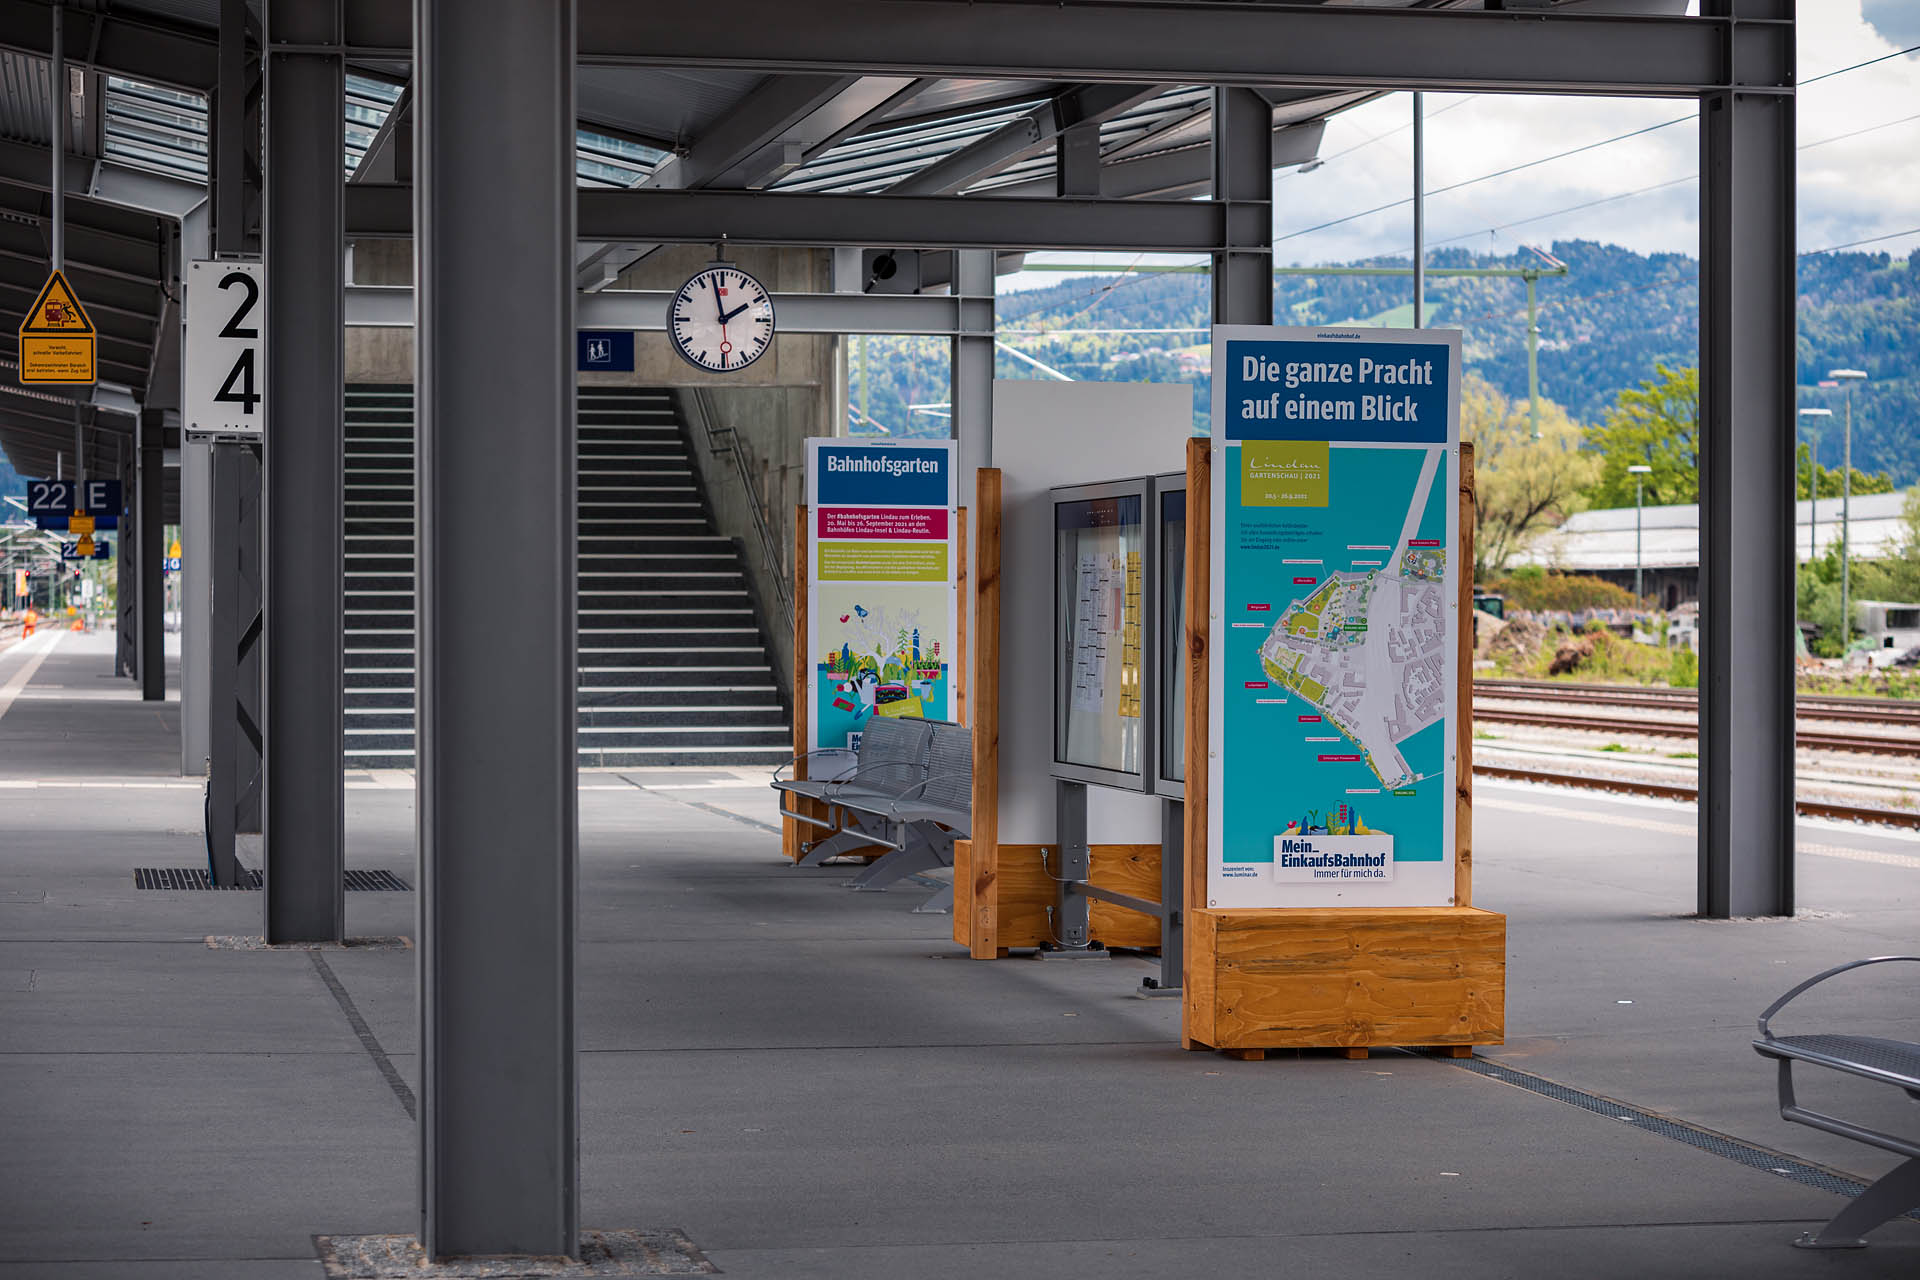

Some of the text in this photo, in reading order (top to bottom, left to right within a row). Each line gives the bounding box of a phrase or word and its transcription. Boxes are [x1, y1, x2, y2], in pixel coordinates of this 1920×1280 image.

[217, 272, 259, 339] 2
[213, 348, 261, 414] 4
[1242, 355, 1433, 389] Die ganze Pracht
[1241, 393, 1419, 422] auf einem Blick
[827, 455, 939, 477] Bahnhofsgarten
[1250, 456, 1321, 469] Lindau
[1249, 472, 1299, 480] GARTENSCHAU
[33, 483, 107, 509] 22 E
[1281, 853, 1386, 868] EinkaufsBahnhof
[1314, 869, 1386, 878] Immer für mich da.
